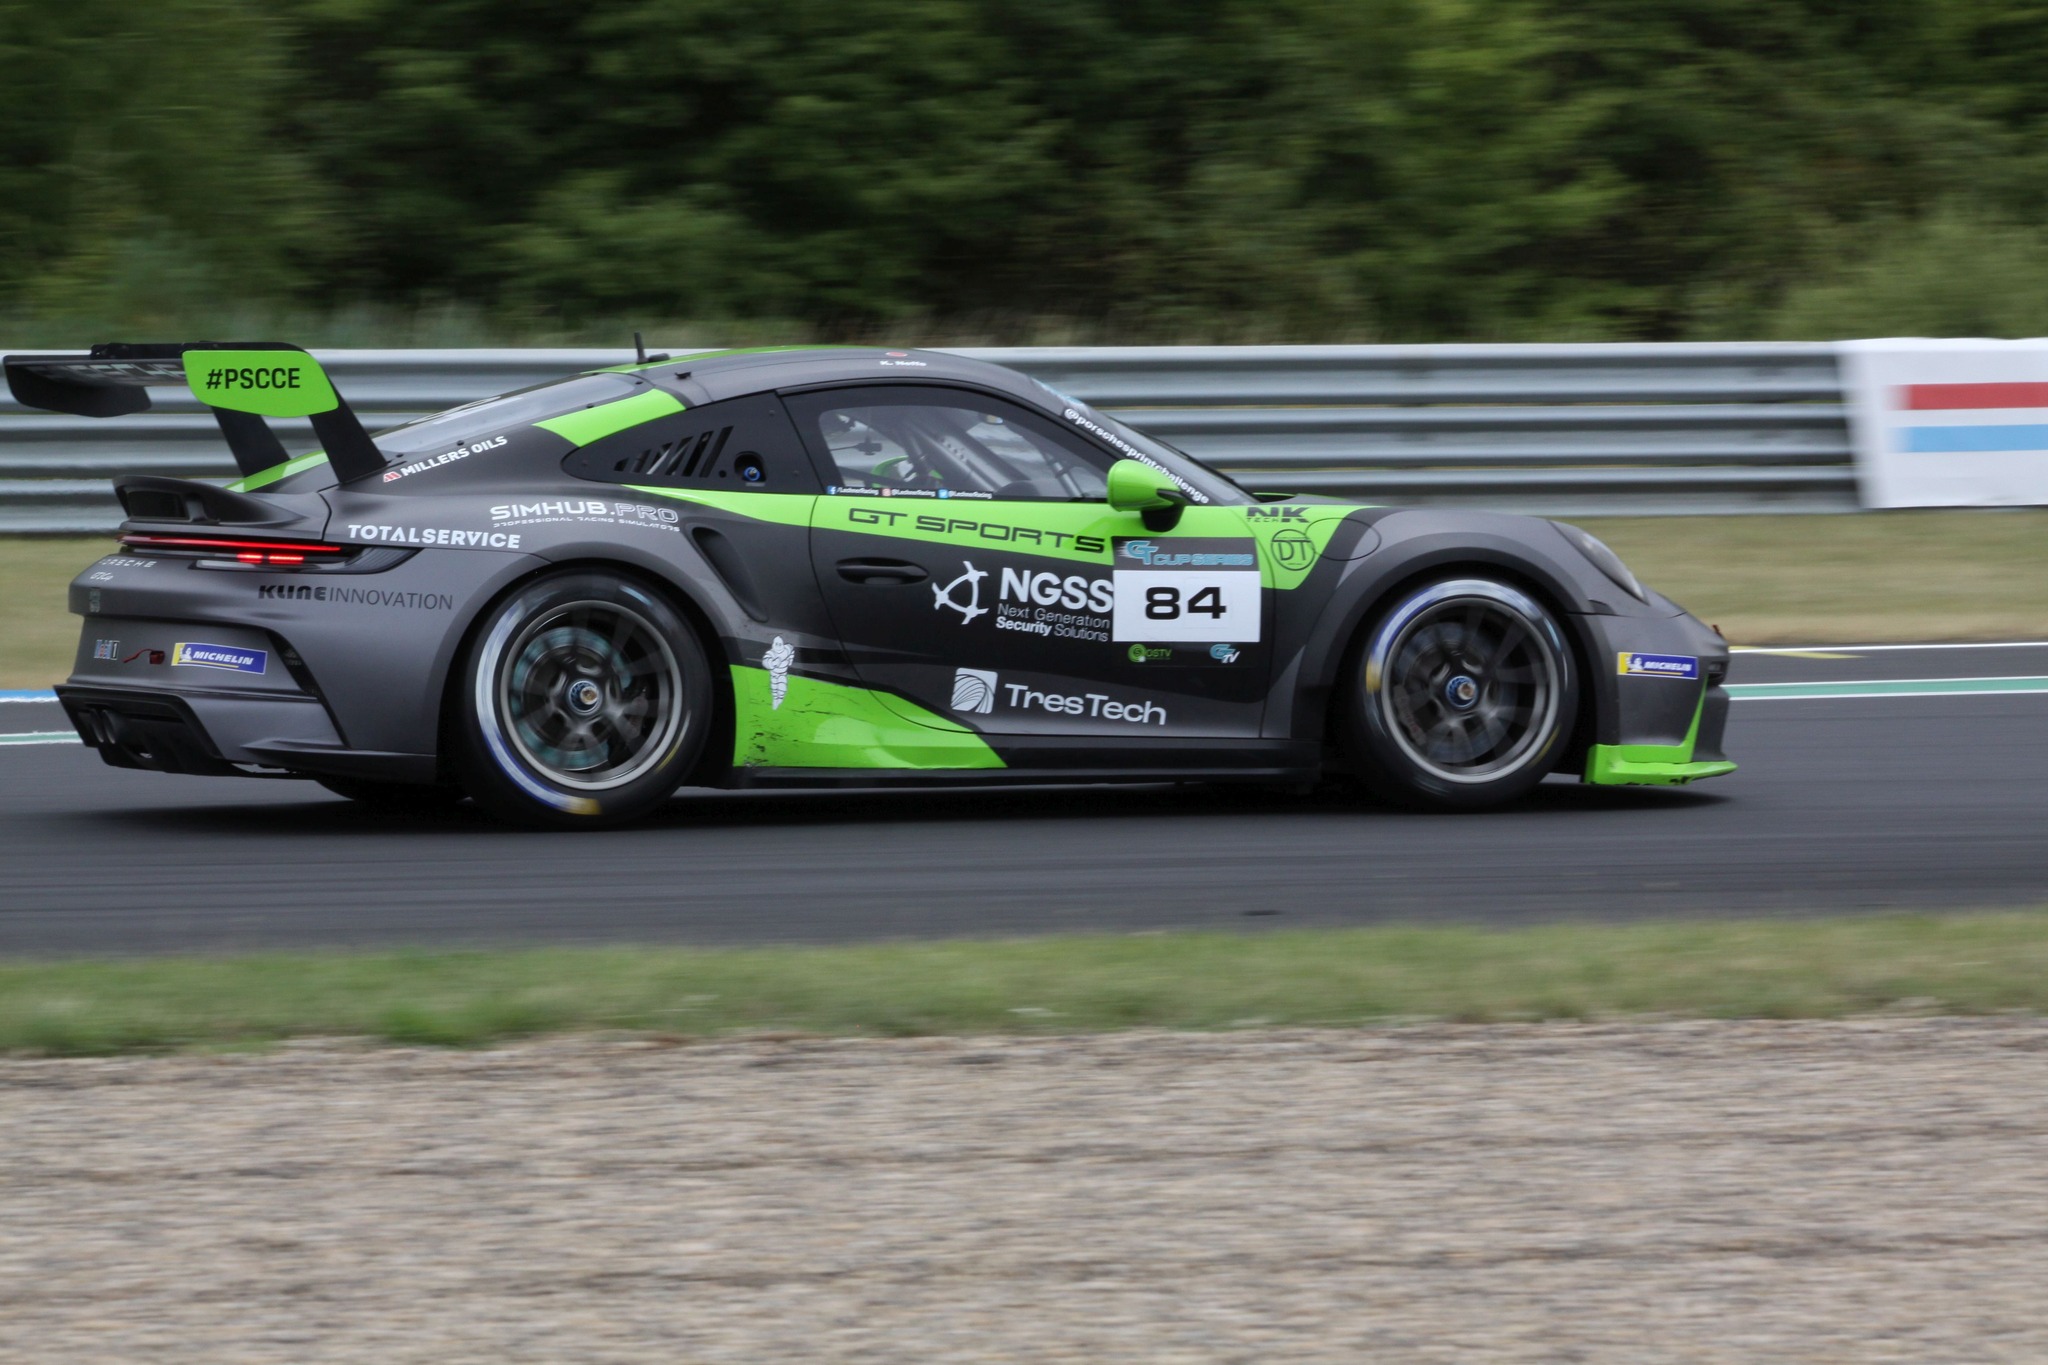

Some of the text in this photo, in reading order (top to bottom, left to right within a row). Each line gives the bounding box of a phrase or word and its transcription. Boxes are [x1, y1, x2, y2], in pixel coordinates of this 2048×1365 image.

[206, 368, 300, 389] #PSCCE
[400, 436, 508, 476] MILLERS OILS
[490, 501, 679, 524] SIMHUB.PRO
[1247, 507, 1311, 523] NK
[849, 508, 1105, 554] GT SPORTS
[1000, 567, 1114, 613] NGSS
[1145, 586, 1227, 620] 84
[996, 616, 1109, 642] Security Solutions
[998, 603, 1110, 629] Next Generation
[193, 651, 254, 666] MICHELIN
[1643, 661, 1692, 672] MICHELIN
[1004, 683, 1166, 726] TresTech
